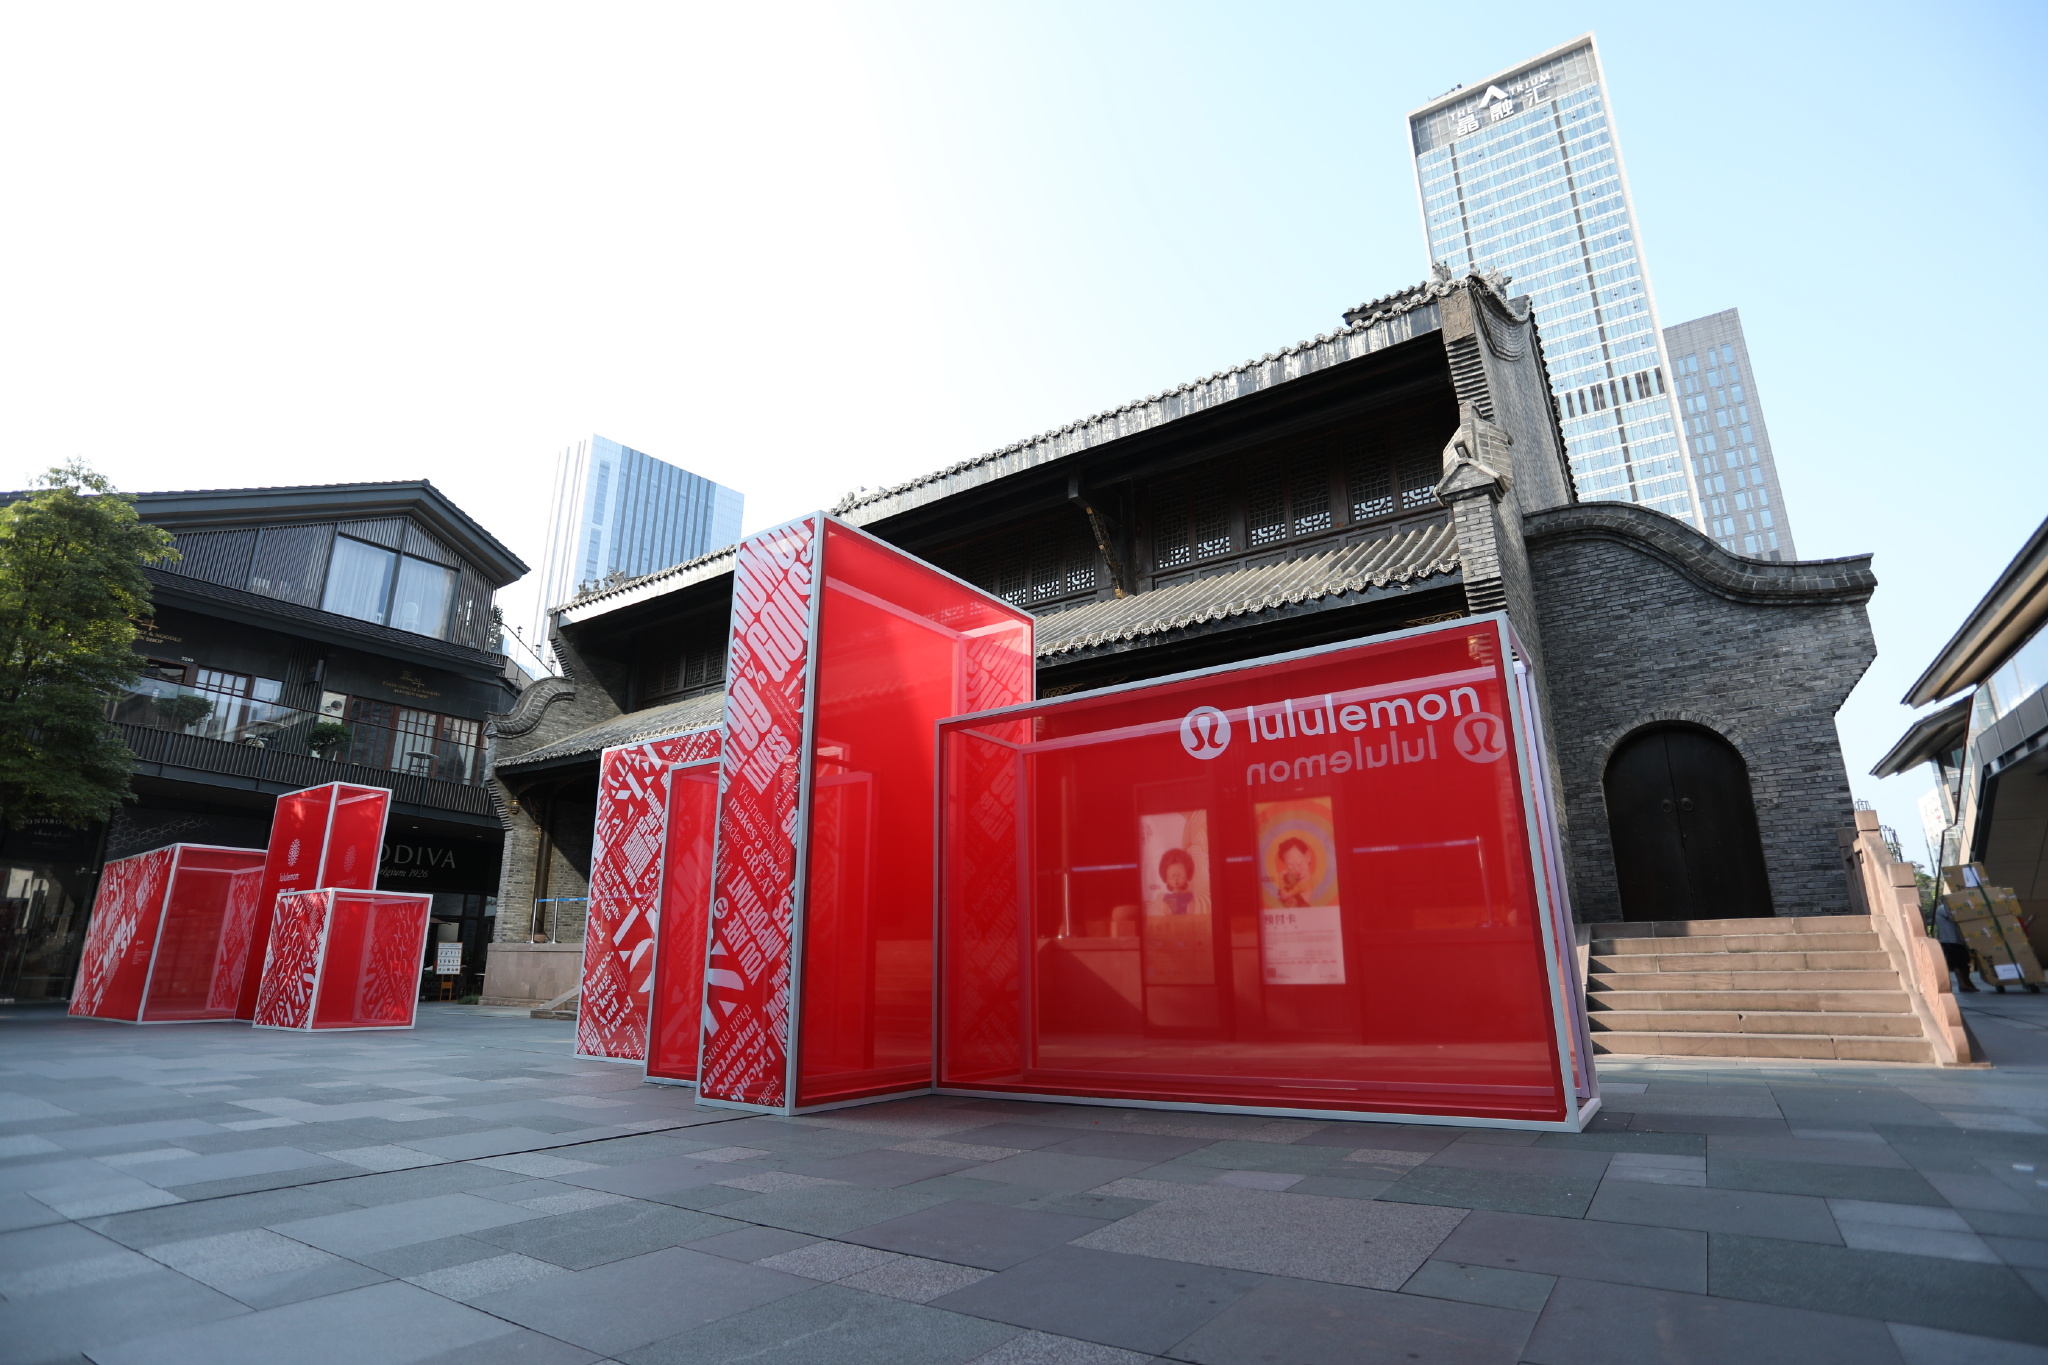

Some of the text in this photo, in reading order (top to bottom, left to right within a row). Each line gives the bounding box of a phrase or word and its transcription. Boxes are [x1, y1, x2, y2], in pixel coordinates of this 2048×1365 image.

[1449, 105, 1474, 120] THE
[1457, 82, 1551, 137] 晶融汇
[155, 633, 183, 643] NOODLE
[1246, 686, 1481, 743] lululemon
[742, 724, 792, 795] ILLNESS
[728, 797, 758, 840] makes
[758, 848, 787, 884] good
[738, 782, 790, 865] Vulnerability
[408, 868, 429, 878] 1926
[605, 854, 621, 886] Sweat
[619, 883, 632, 906] once
[720, 808, 778, 900] leader GREAT
[722, 912, 766, 986] YOU ARE
[602, 995, 634, 1040] Travel
[730, 1004, 752, 1033] than
[701, 1018, 762, 1094] important
[717, 1030, 767, 1096] are more
[730, 1046, 775, 1102] Friends
